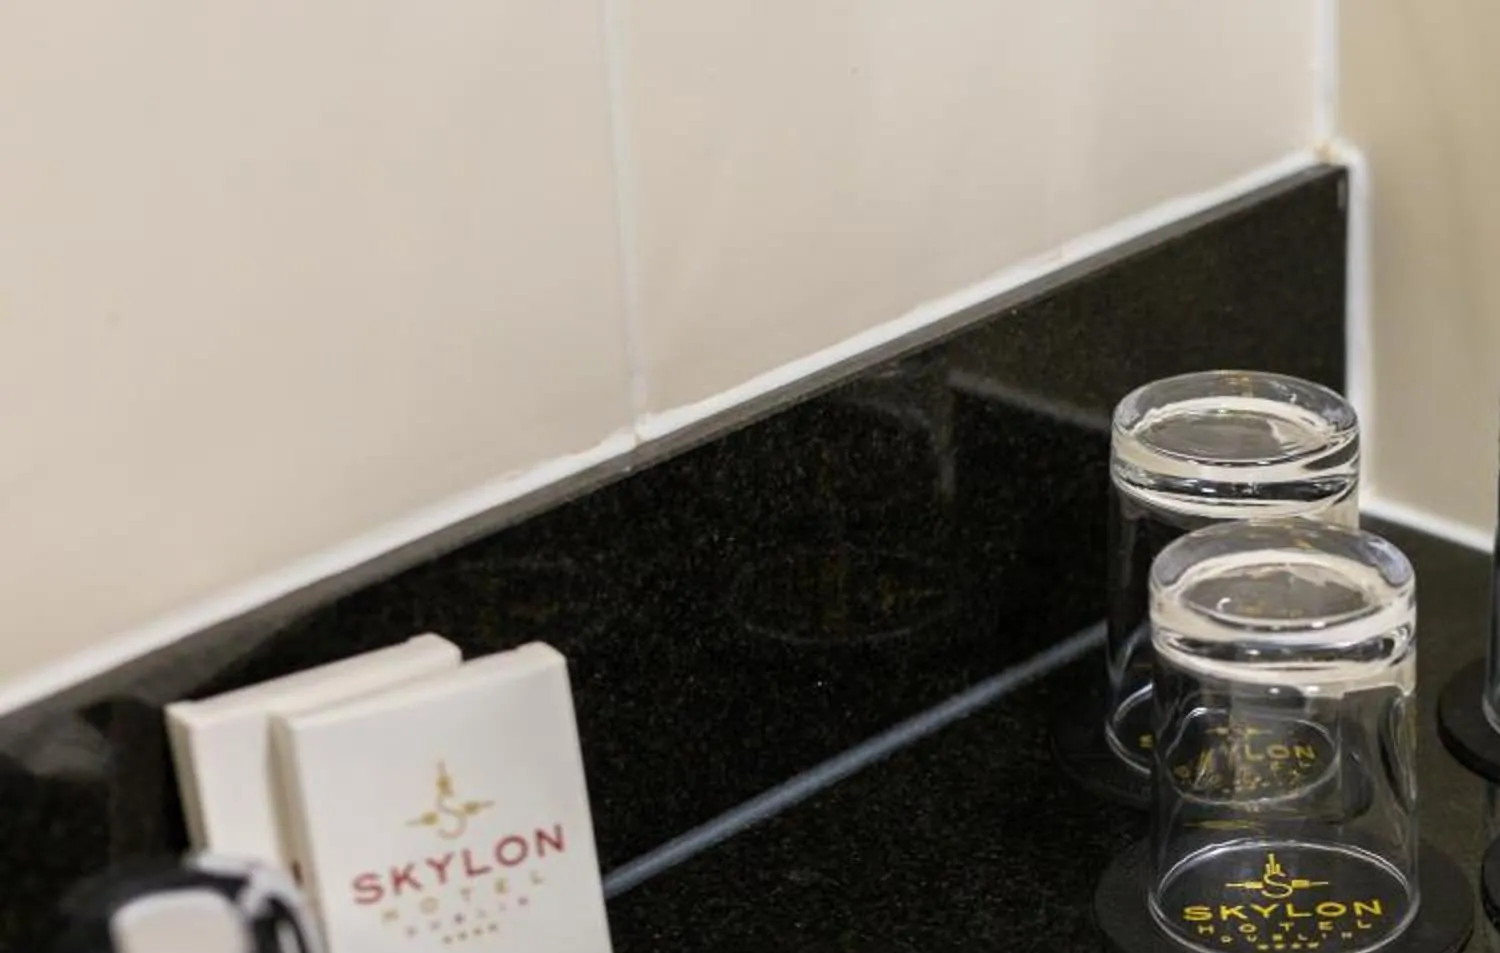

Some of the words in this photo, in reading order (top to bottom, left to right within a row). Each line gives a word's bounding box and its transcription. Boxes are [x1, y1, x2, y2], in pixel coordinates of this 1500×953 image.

[352, 823, 565, 905] SKYLON
[1183, 899, 1382, 921] SKYLON
[1198, 920, 1372, 934] HOTEL
